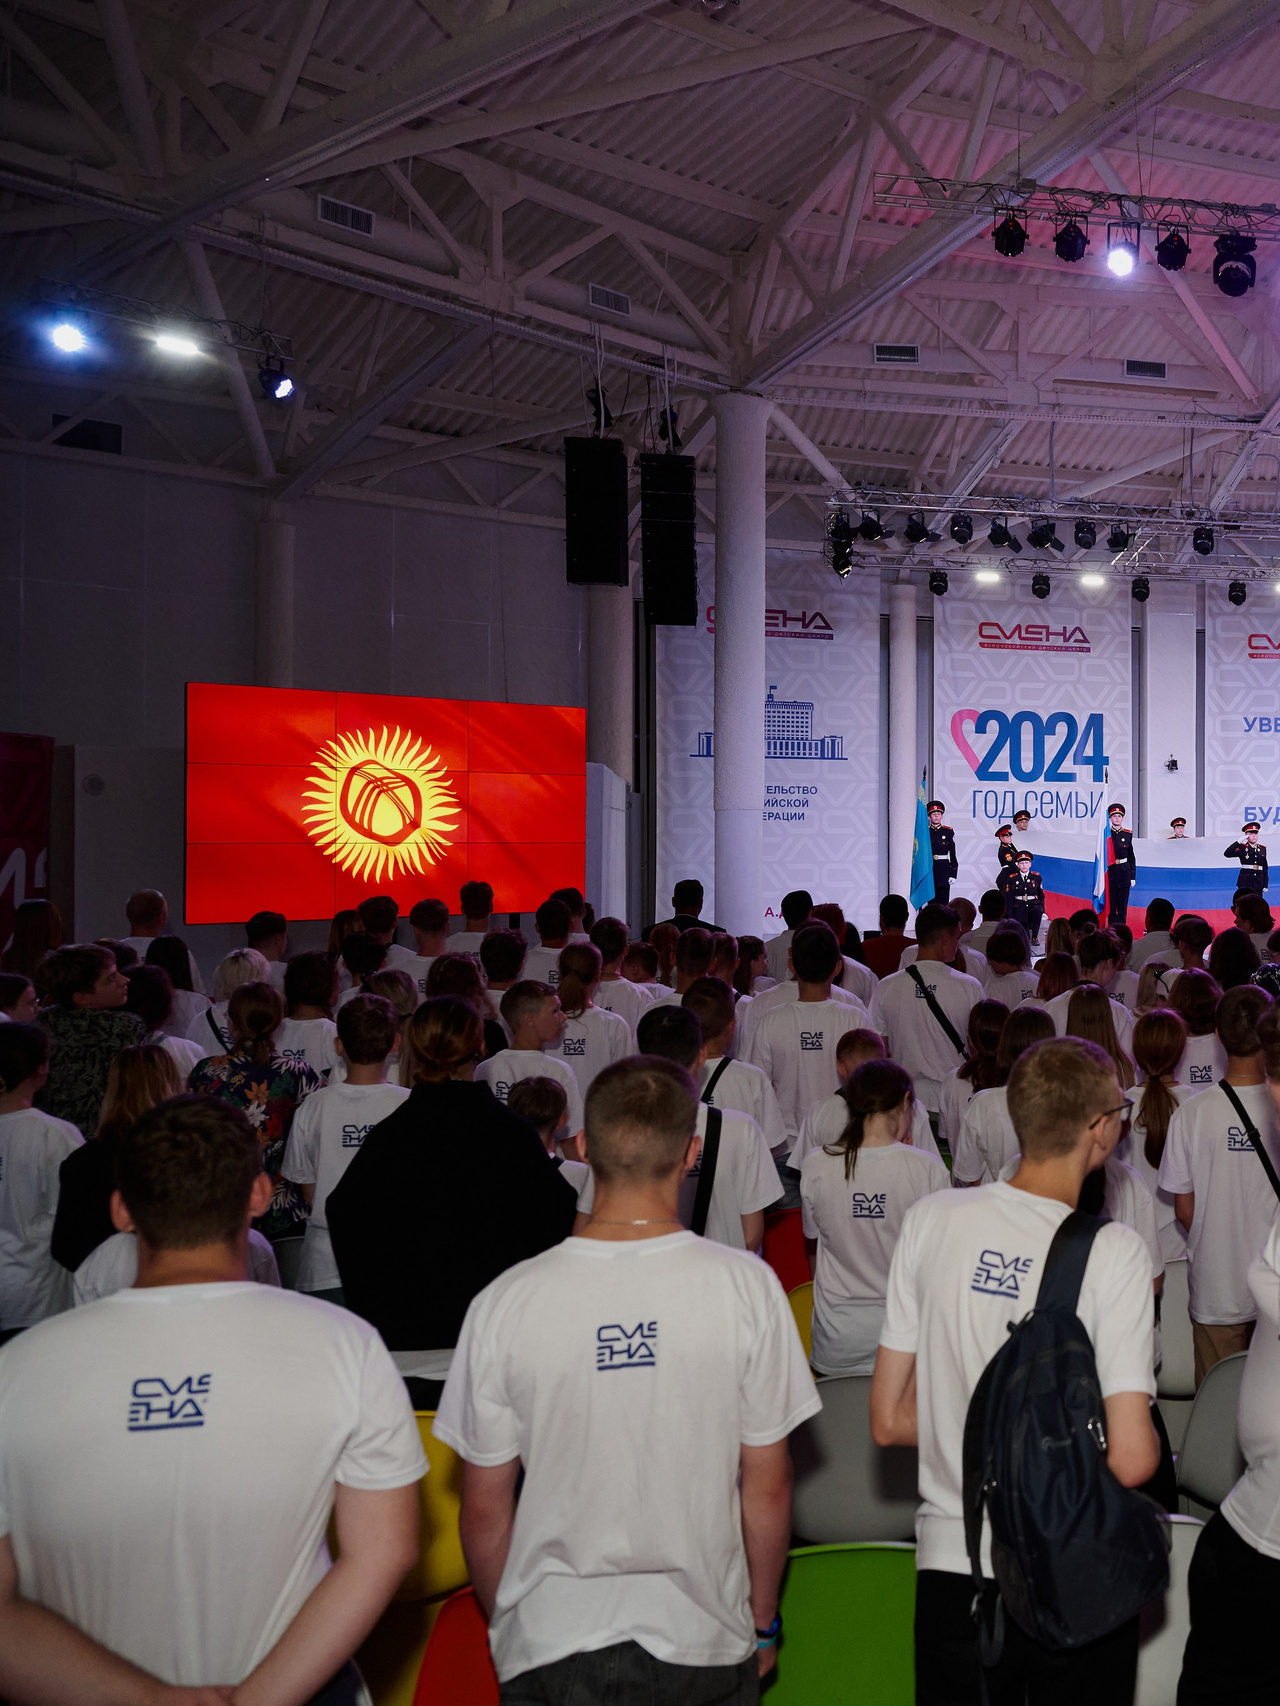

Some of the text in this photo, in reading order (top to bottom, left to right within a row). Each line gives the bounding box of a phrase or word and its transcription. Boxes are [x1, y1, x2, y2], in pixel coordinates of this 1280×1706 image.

[978, 621, 1091, 644] СМЕНА
[974, 709, 1110, 783] 2024
[765, 785, 818, 795] ЕЛЬСТВО
[763, 797, 809, 808] ИЙСКОЙ
